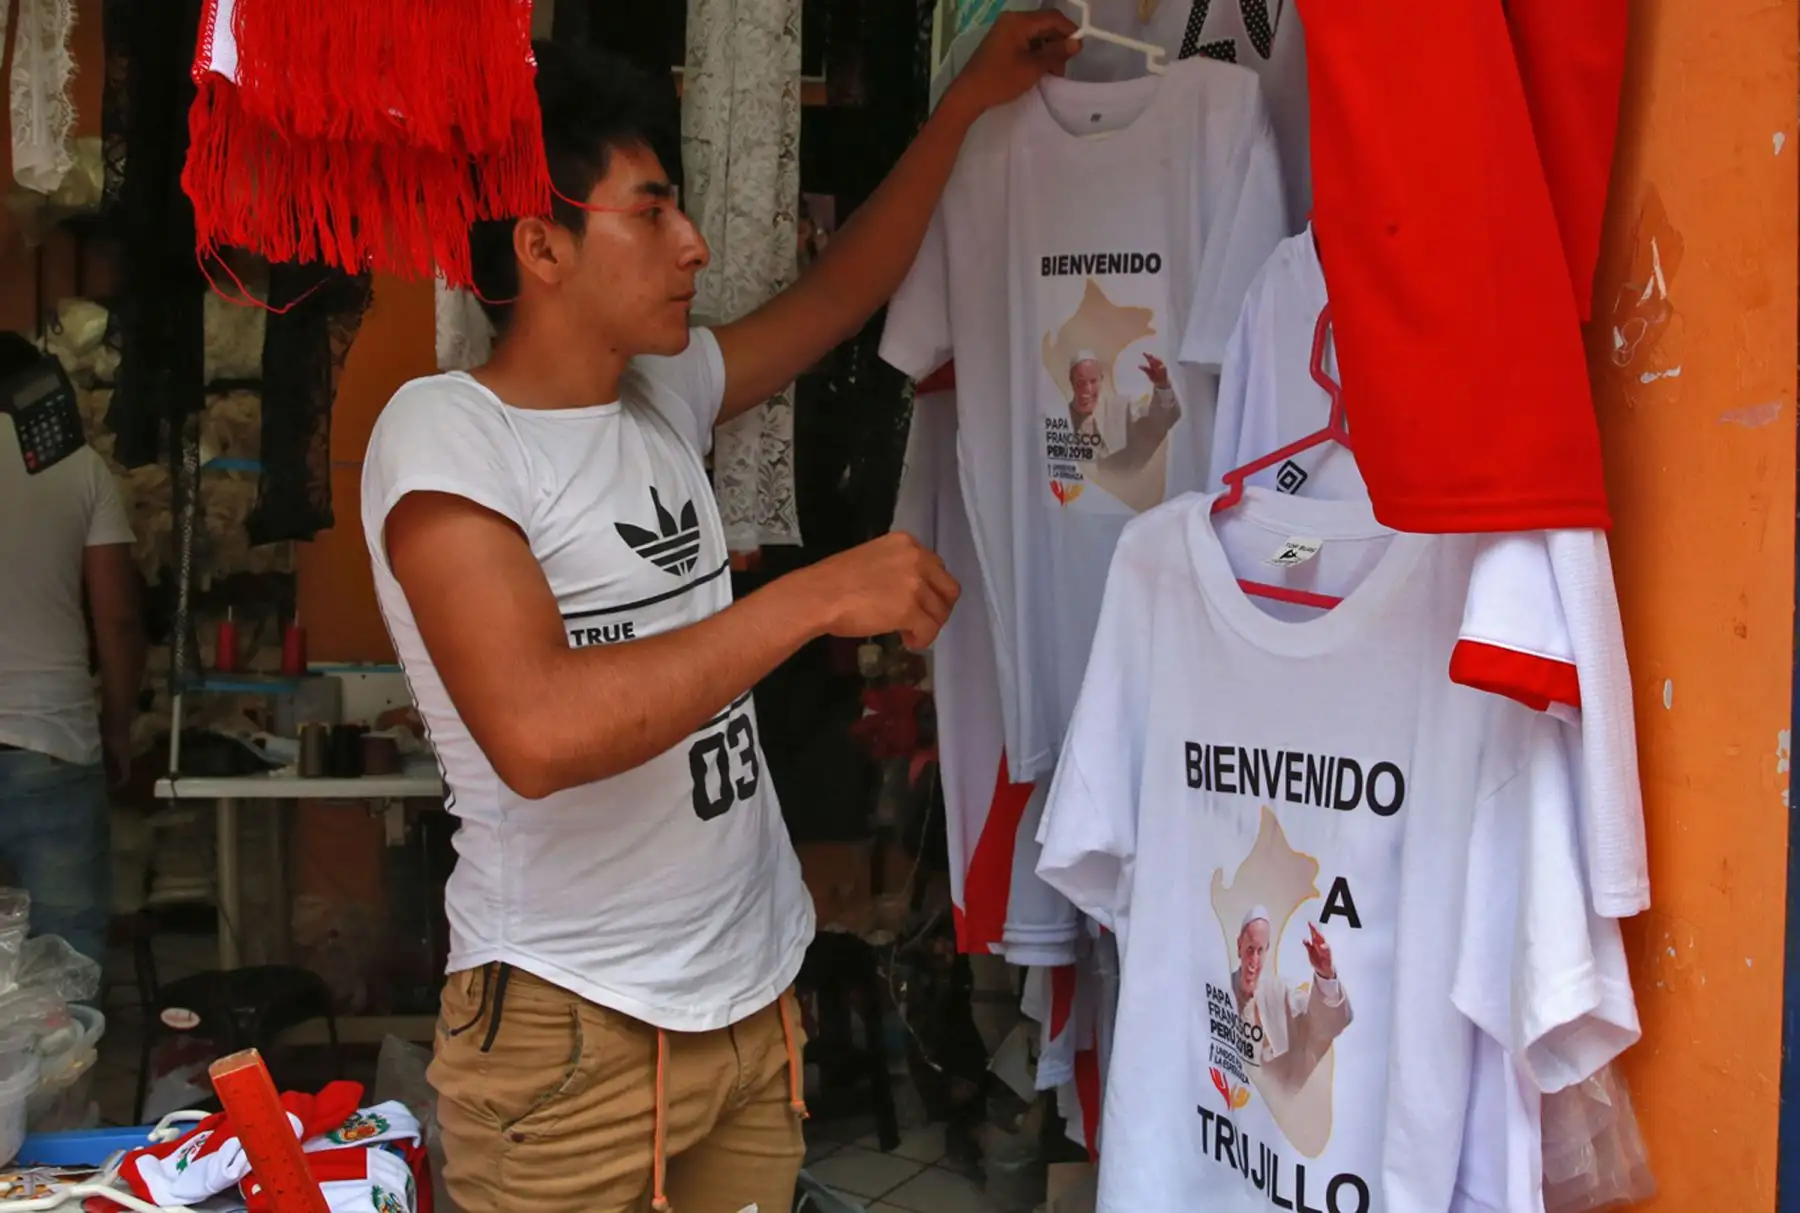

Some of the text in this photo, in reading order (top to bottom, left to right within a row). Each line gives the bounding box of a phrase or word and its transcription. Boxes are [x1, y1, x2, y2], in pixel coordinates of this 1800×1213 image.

[1041, 253, 1162, 276] BIENVENIDO
[1045, 417, 1069, 430] PAPA
[570, 621, 636, 647] TRUE
[688, 713, 760, 822] 03
[1185, 741, 1405, 816] BIENVENIDO
[1319, 876, 1362, 929] A
[1205, 983, 1233, 1010] PAPA
[1208, 1000, 1263, 1042] FRANCSCO
[1197, 1104, 1370, 1213] TRUJILLO
